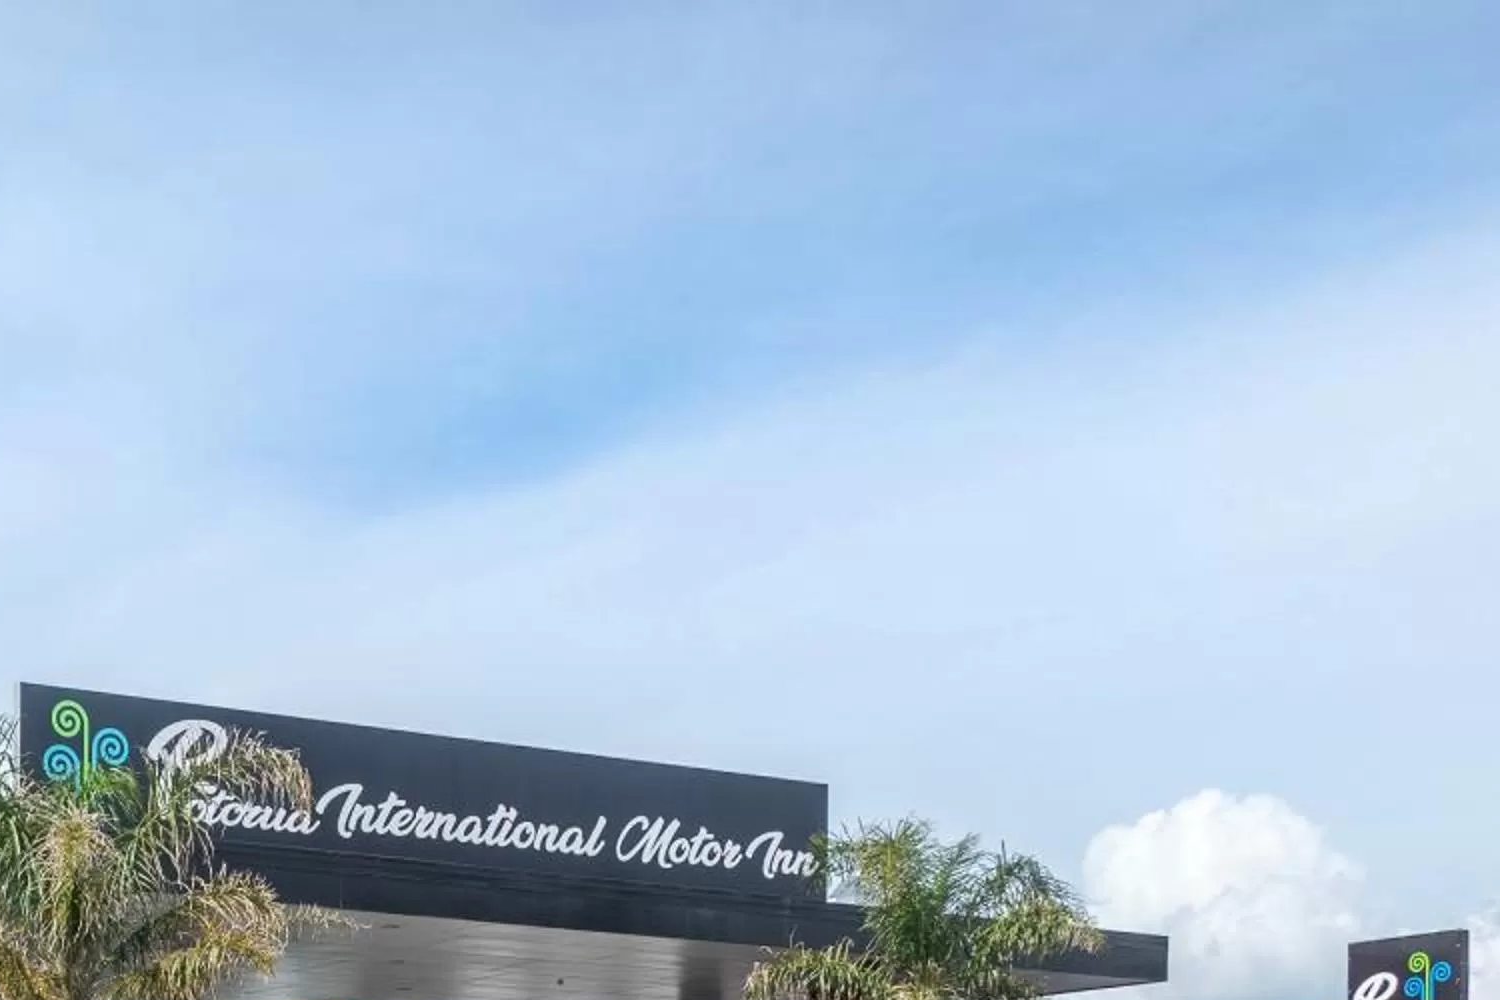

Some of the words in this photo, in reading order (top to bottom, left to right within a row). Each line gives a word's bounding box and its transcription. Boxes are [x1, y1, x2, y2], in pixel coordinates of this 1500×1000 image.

[315, 783, 605, 857] International
[615, 815, 743, 869] Motor
[745, 831, 818, 879] Inn
